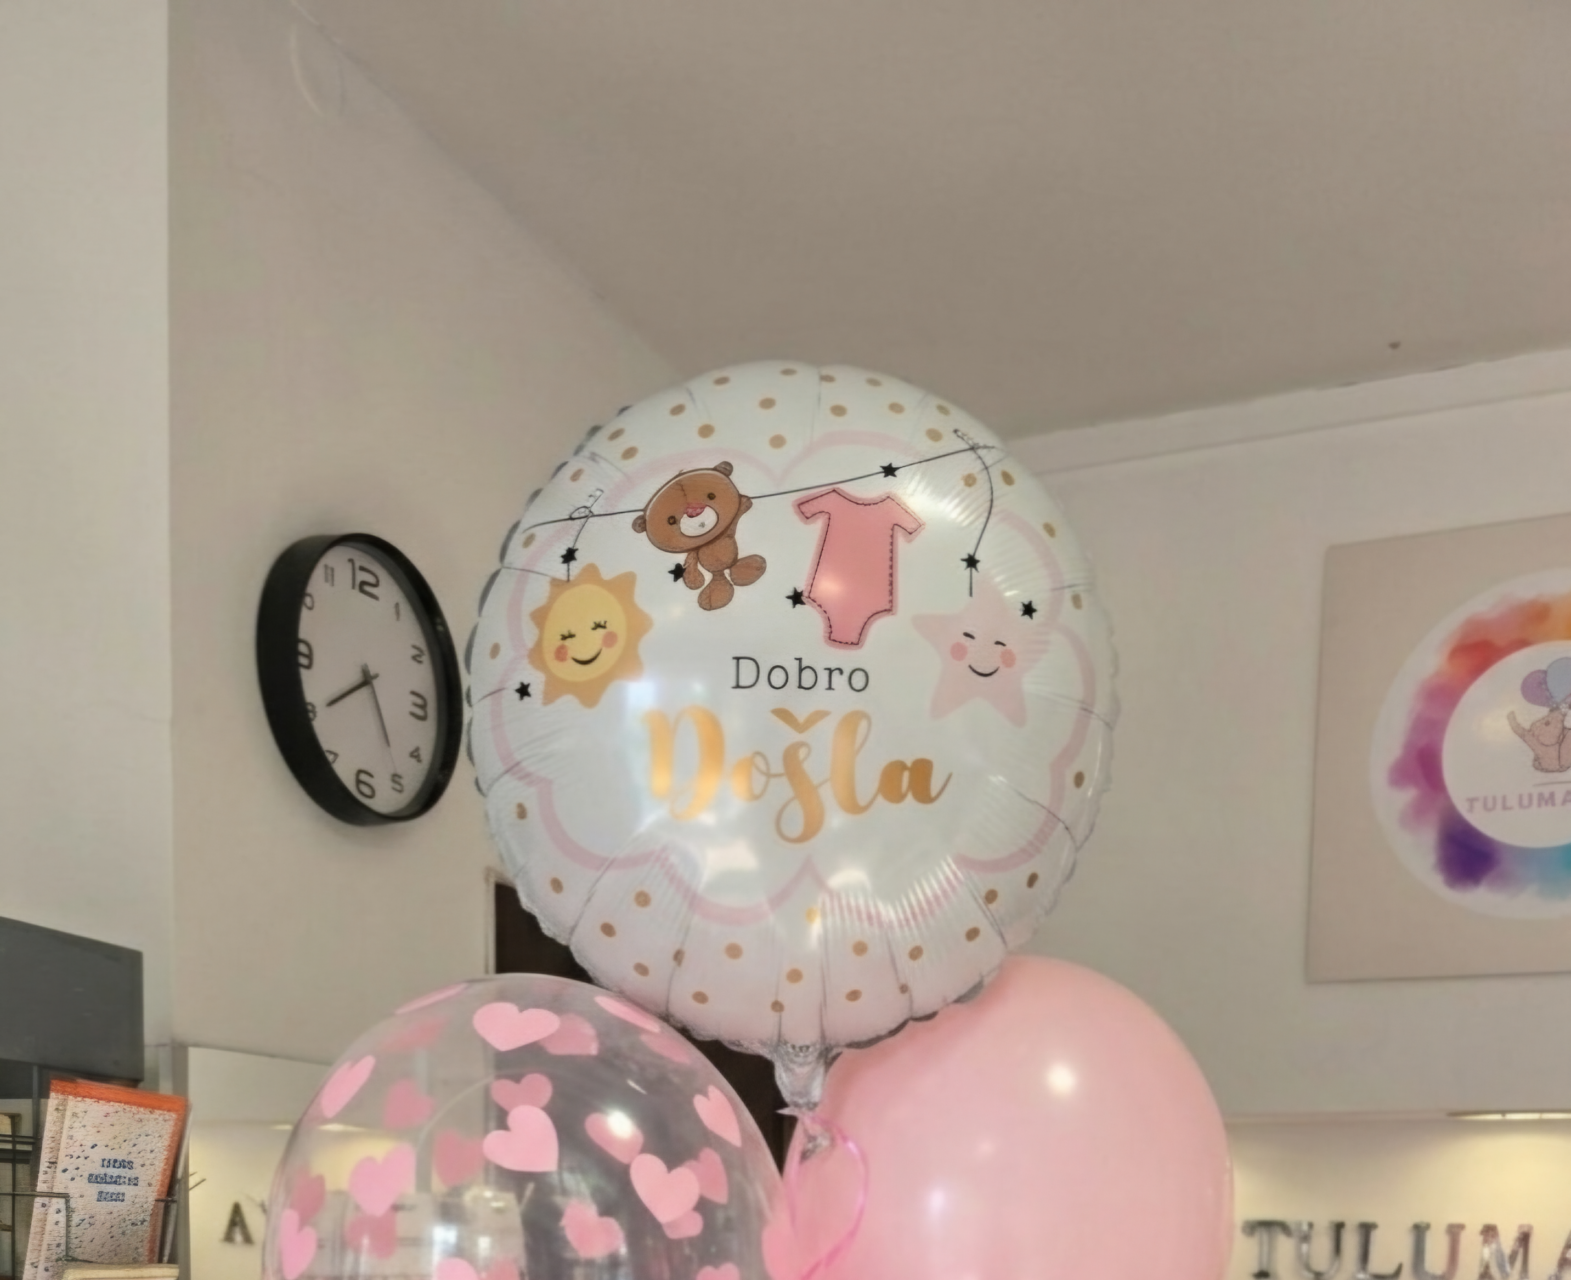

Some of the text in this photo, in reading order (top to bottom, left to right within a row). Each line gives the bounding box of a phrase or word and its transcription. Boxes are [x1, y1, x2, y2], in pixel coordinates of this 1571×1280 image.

[347, 557, 381, 602] 12
[731, 656, 870, 693] Dobro
[408, 690, 429, 723] 3
[354, 768, 377, 800] 6
[641, 704, 954, 844] Došla
